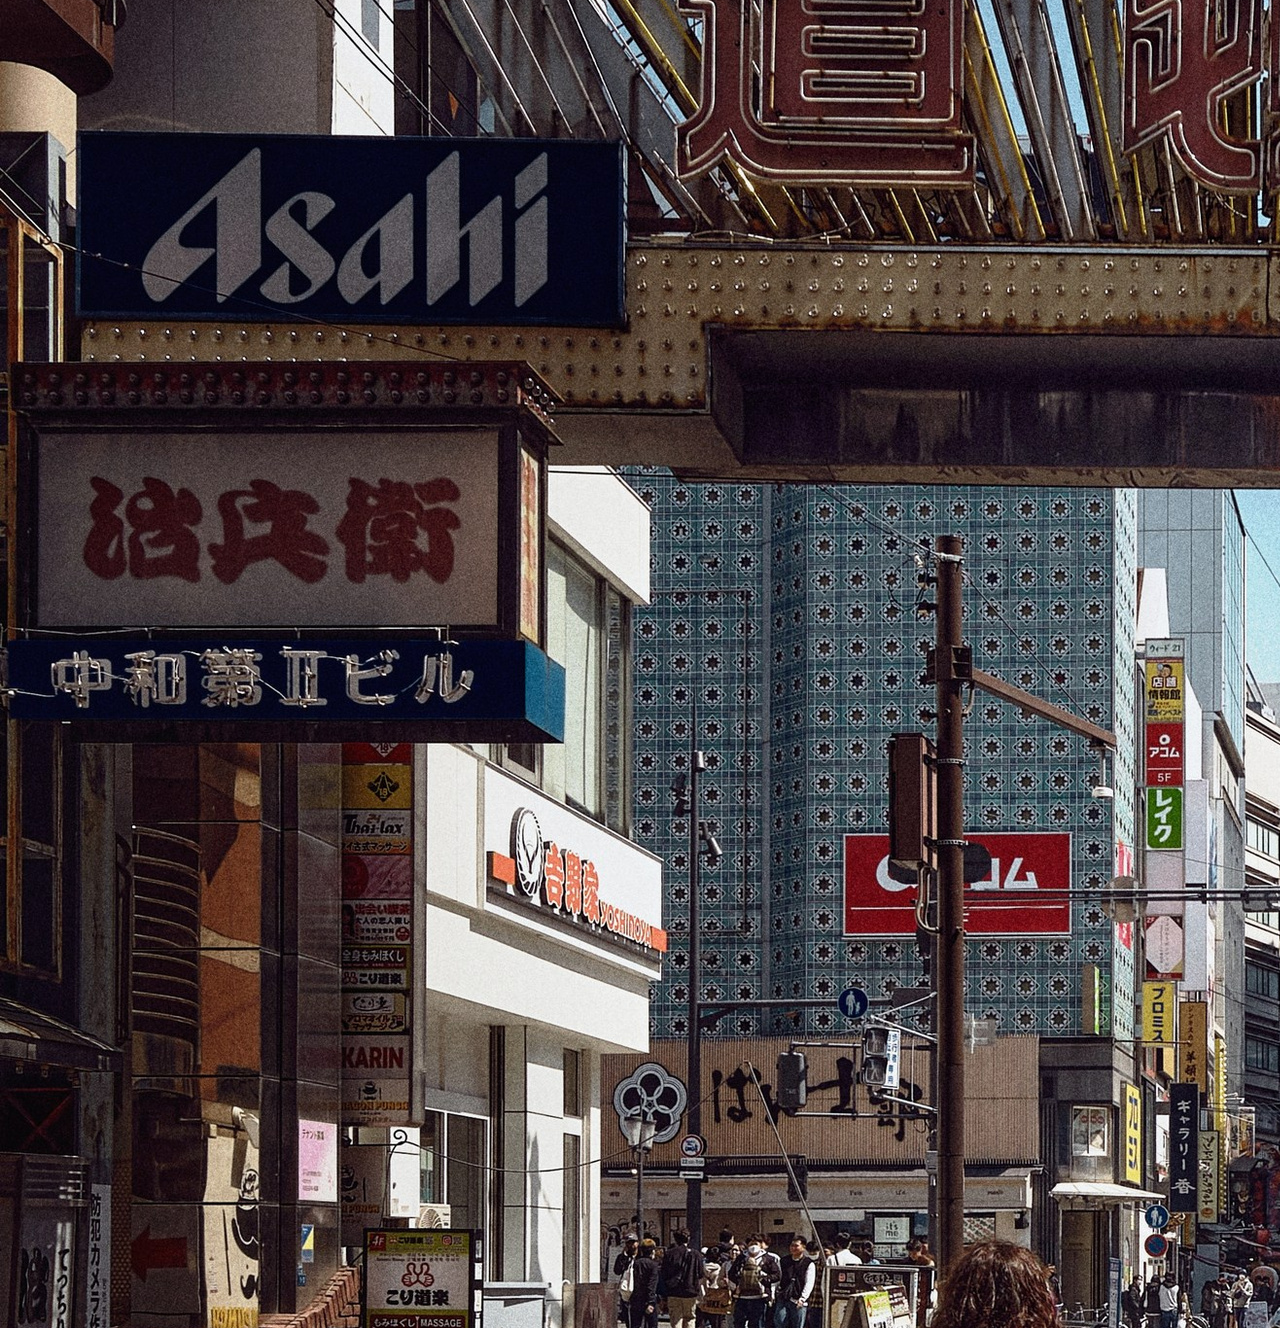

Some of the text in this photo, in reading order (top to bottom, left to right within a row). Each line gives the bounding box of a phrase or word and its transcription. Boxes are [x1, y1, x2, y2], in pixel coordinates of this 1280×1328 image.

[142, 147, 548, 307] Asahi
[1149, 747, 1180, 758] アコム
[1157, 773, 1171, 782] 5F
[1154, 790, 1172, 842] レイク
[545, 842, 599, 924] 吉野家
[600, 901, 653, 948] YOSHINOYA
[359, 972, 403, 985] こり道楽
[1152, 987, 1166, 1042] プロミス
[341, 1046, 404, 1069] KARIN
[386, 1289, 450, 1306] こり道楽
[420, 1318, 462, 1328] MASSAGE
